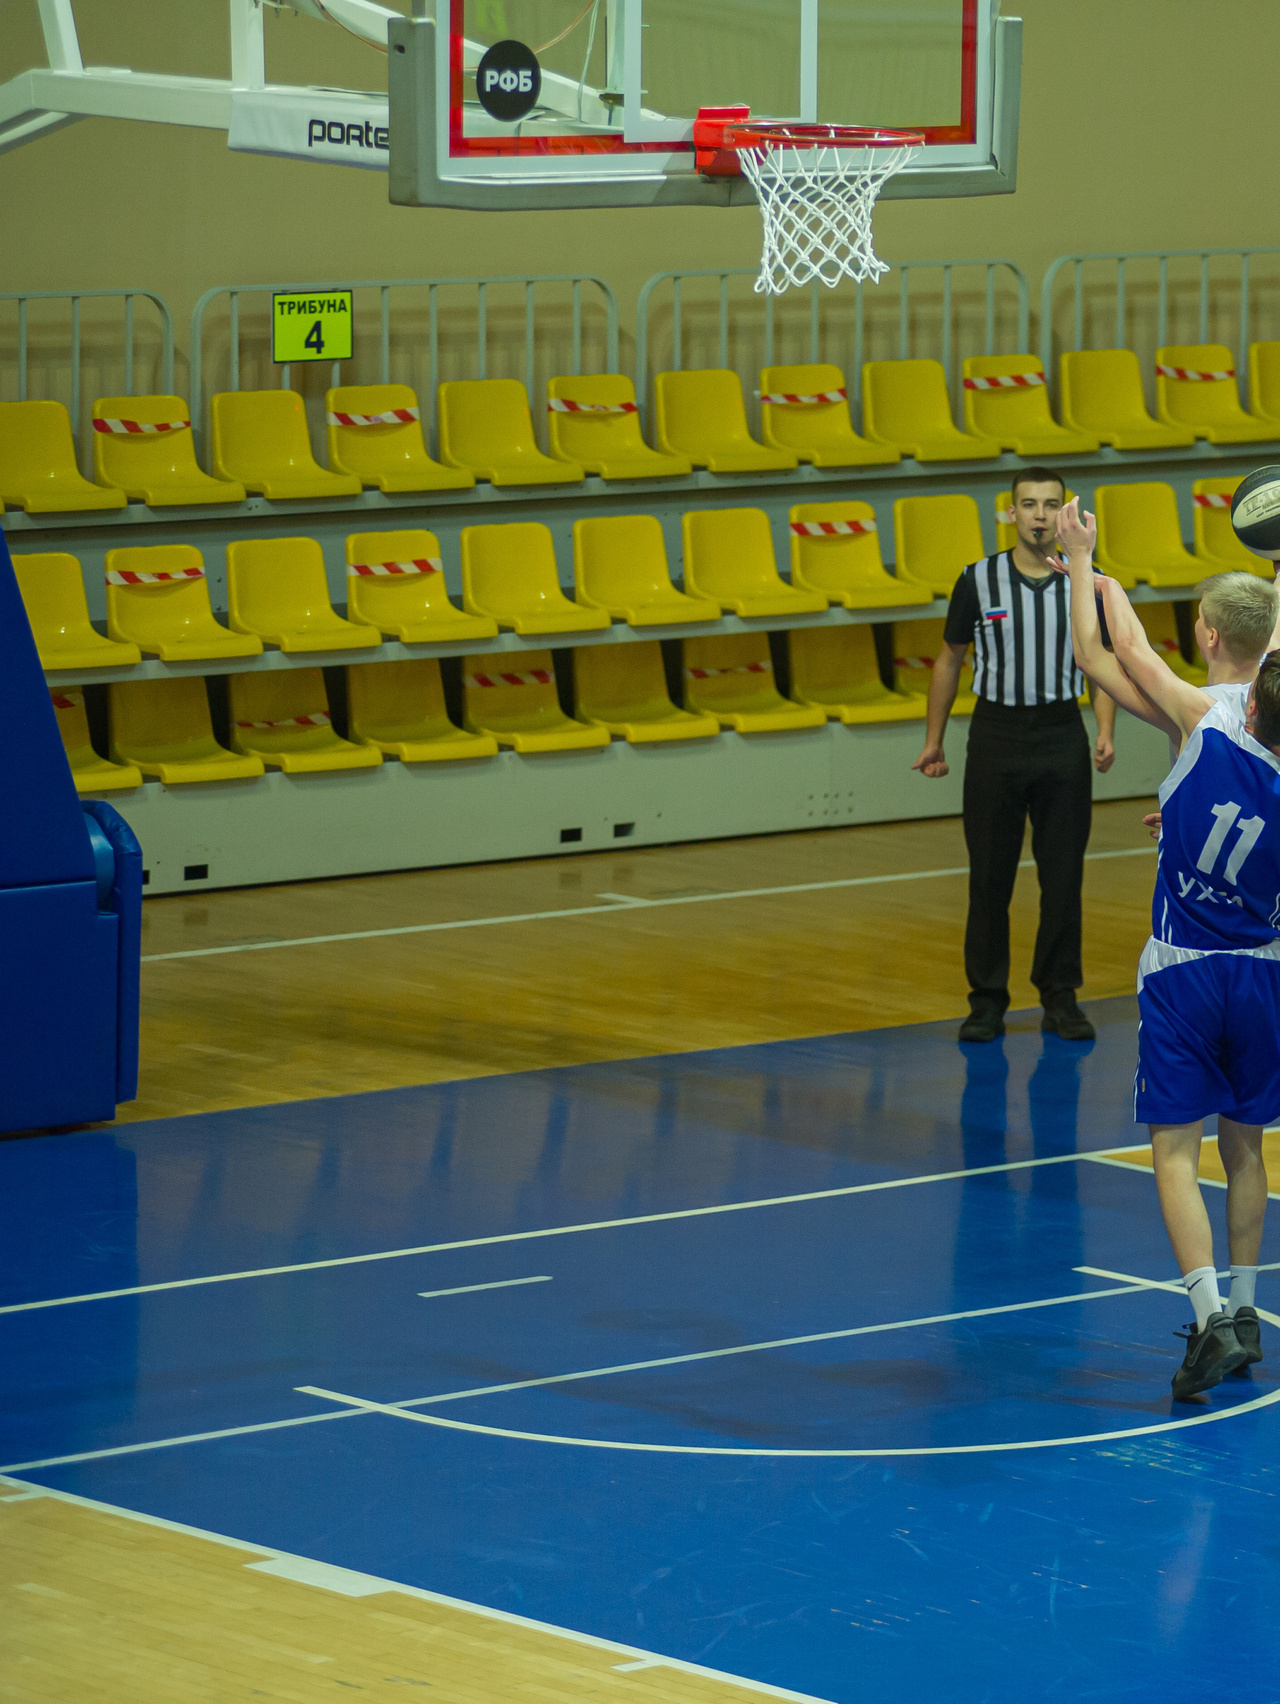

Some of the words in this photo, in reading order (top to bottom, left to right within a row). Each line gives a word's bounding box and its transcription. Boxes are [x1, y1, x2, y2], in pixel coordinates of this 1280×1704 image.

[485, 70, 532, 93] РФБ
[278, 299, 347, 315] ТРИБУНА
[304, 321, 324, 354] 4
[1196, 801, 1265, 886] 11
